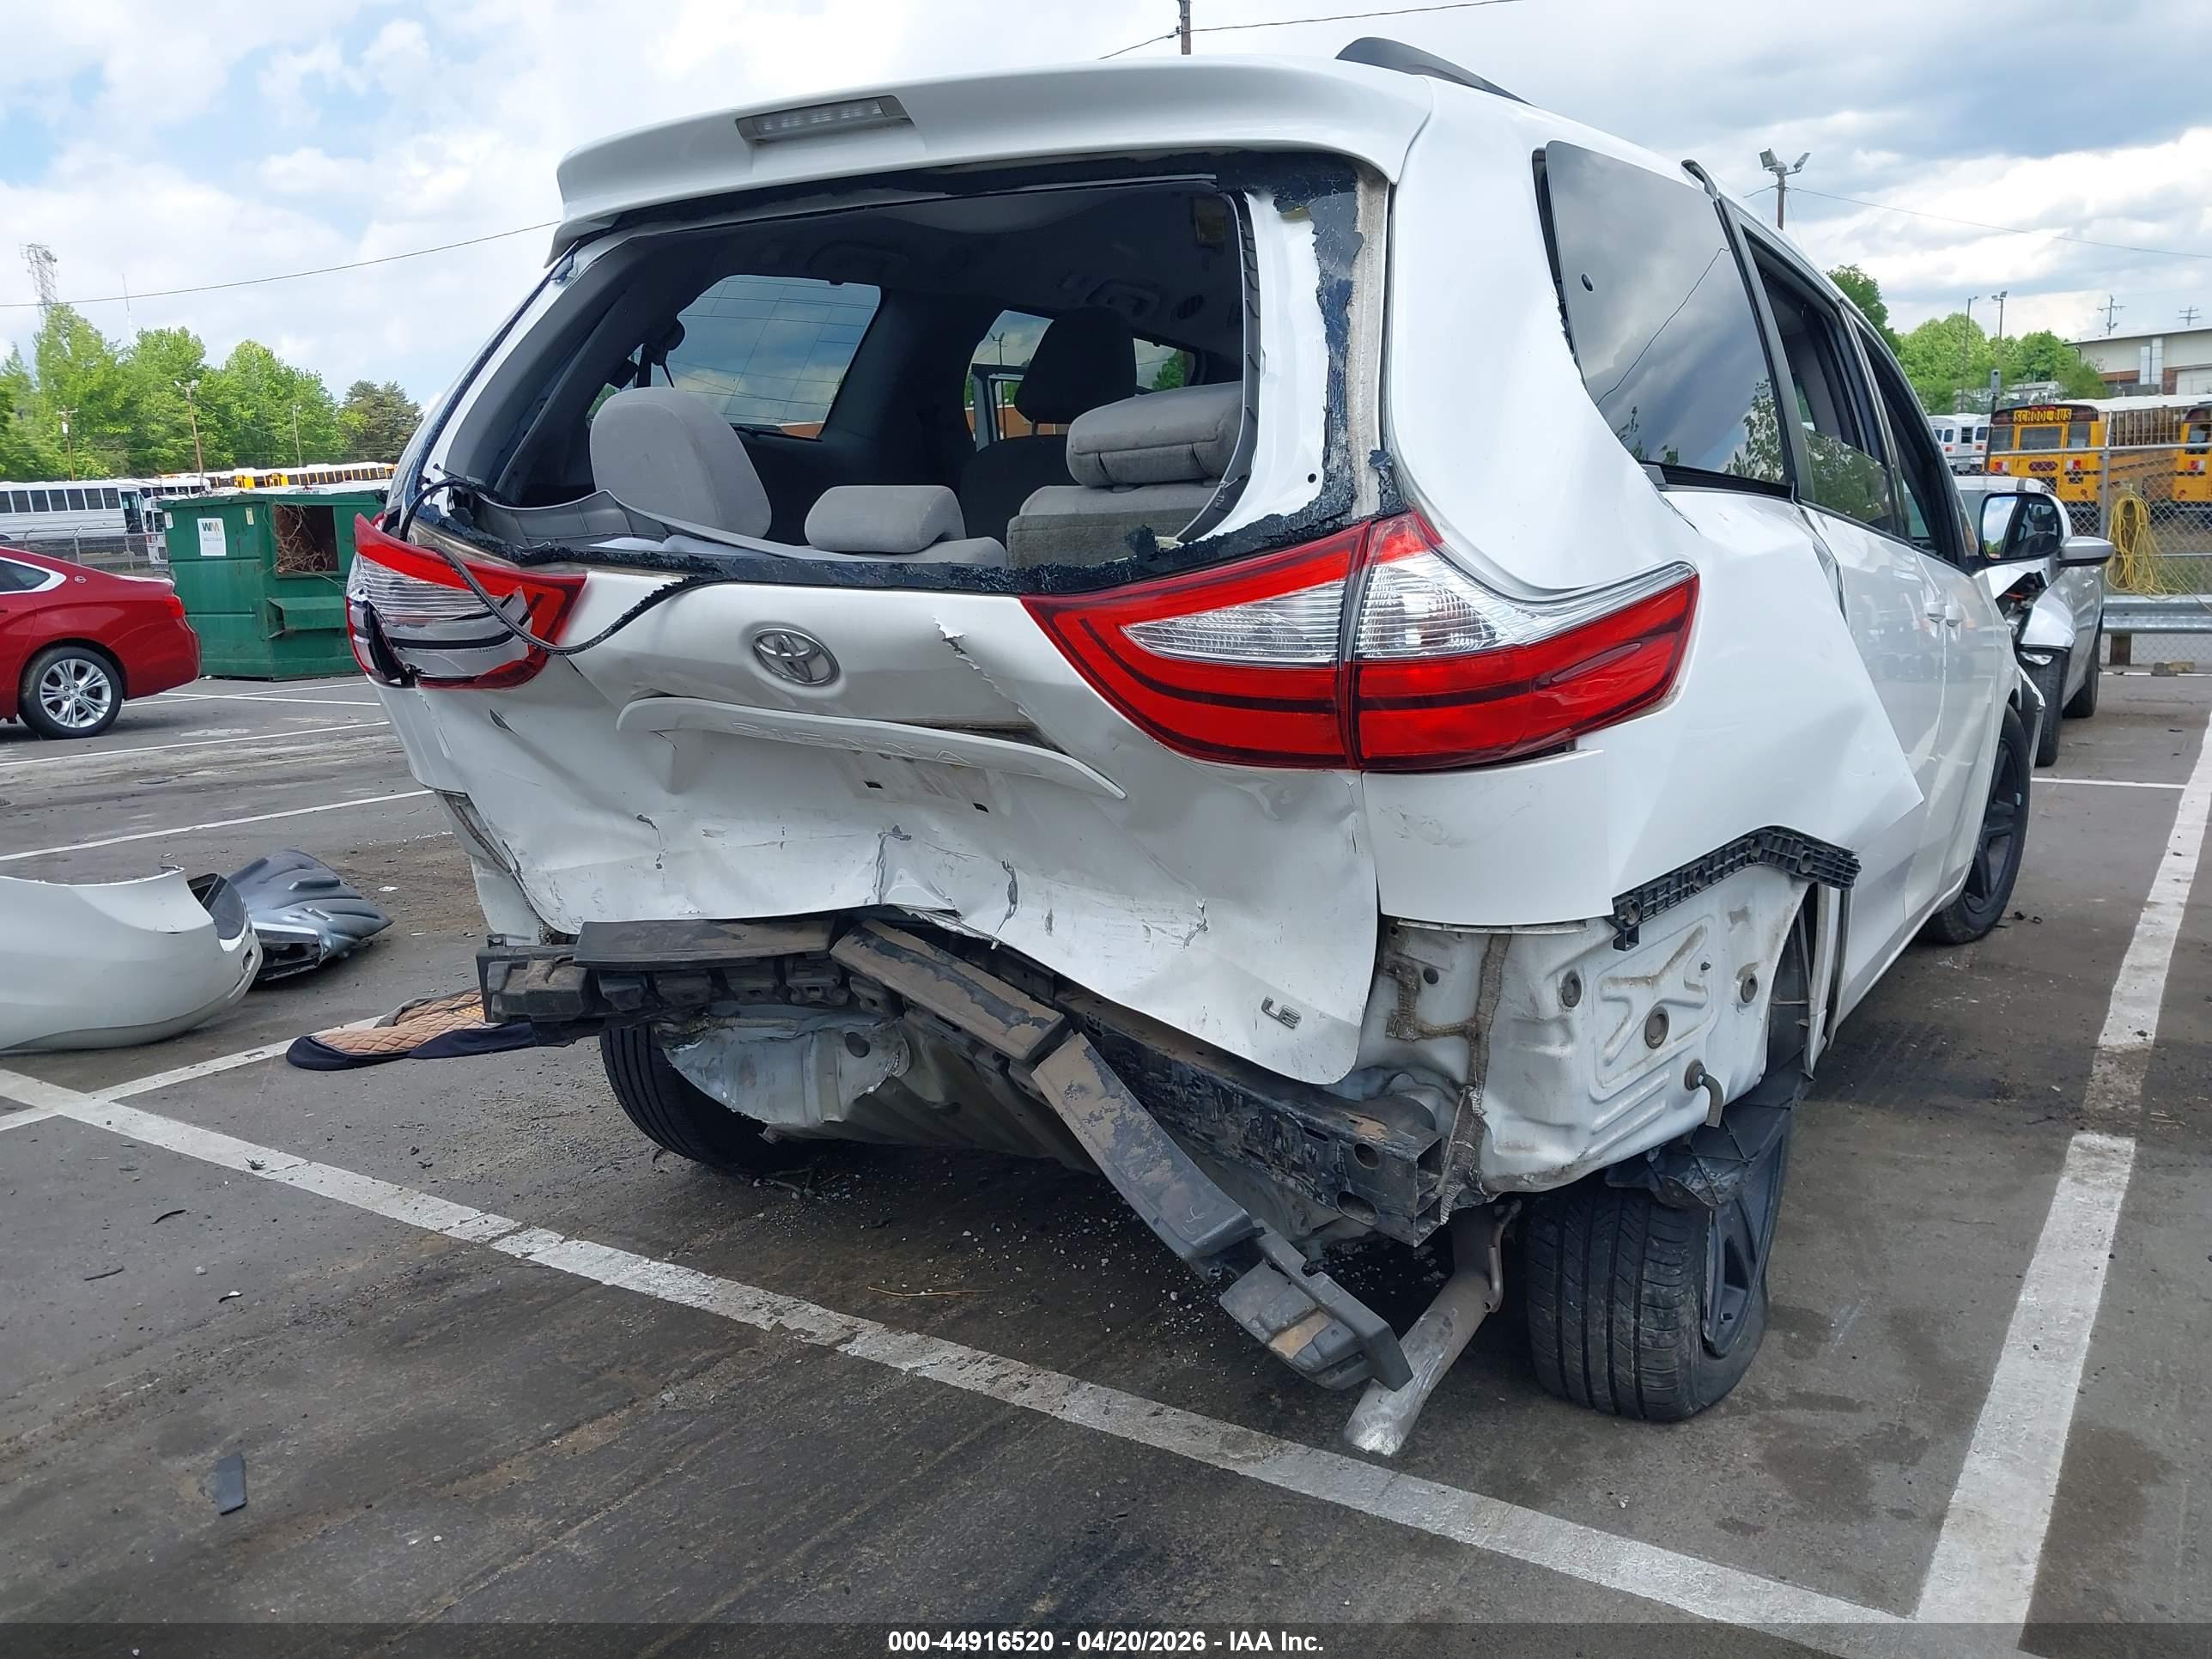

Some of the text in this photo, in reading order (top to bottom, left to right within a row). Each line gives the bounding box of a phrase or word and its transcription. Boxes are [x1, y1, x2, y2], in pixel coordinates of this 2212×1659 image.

[2015, 410, 2071, 422] SCHOOL BUS
[202, 522, 220, 532] WM
[1261, 996, 1300, 1030] LE
